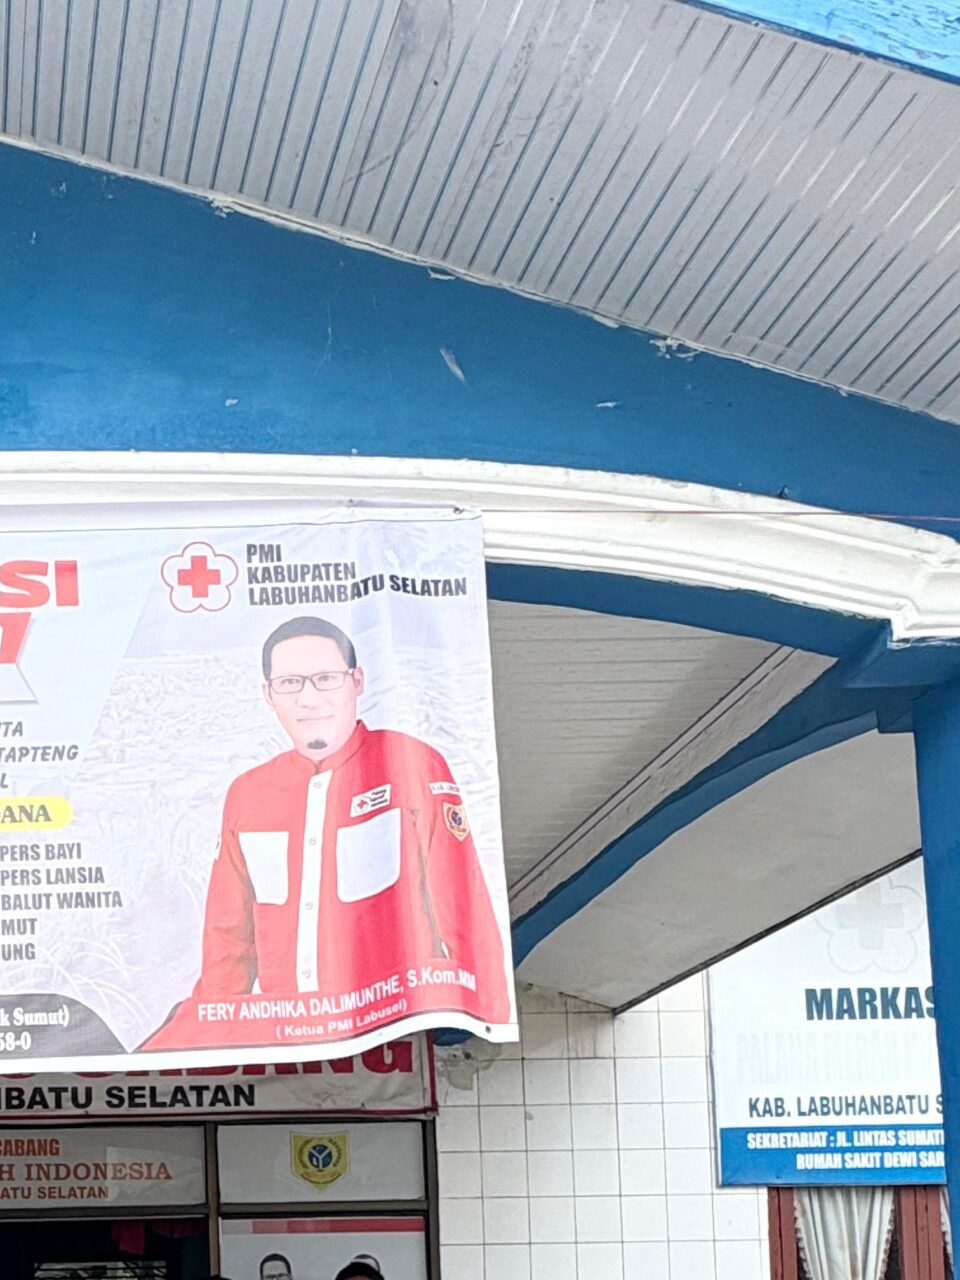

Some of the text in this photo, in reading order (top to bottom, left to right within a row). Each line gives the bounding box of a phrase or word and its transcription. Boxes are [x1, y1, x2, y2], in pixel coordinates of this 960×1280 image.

[246, 543, 282, 564] PMI
[247, 561, 356, 585] KABUPATEN
[248, 573, 467, 606] LABUHANBATU SELATAN
[45, 842, 82, 862] BAYI
[47, 866, 104, 885] LANSIA
[56, 890, 122, 909] WANITA
[198, 1002, 236, 1021] FERY
[239, 998, 307, 1019] ANDHIKA
[327, 1018, 353, 1032] PMI
[105, 1083, 256, 1108] SELATAN
[748, 1096, 790, 1118] KAB.
[797, 1094, 929, 1117] LABUHANBATU
[747, 1131, 827, 1149] SEKRETARIAT
[853, 1130, 896, 1147] LINTAS
[796, 1151, 917, 1170] RUMAH SAKIT DEWI
[25, 1162, 172, 1181] INDONESIA
[37, 1185, 109, 1199] SELATAN
